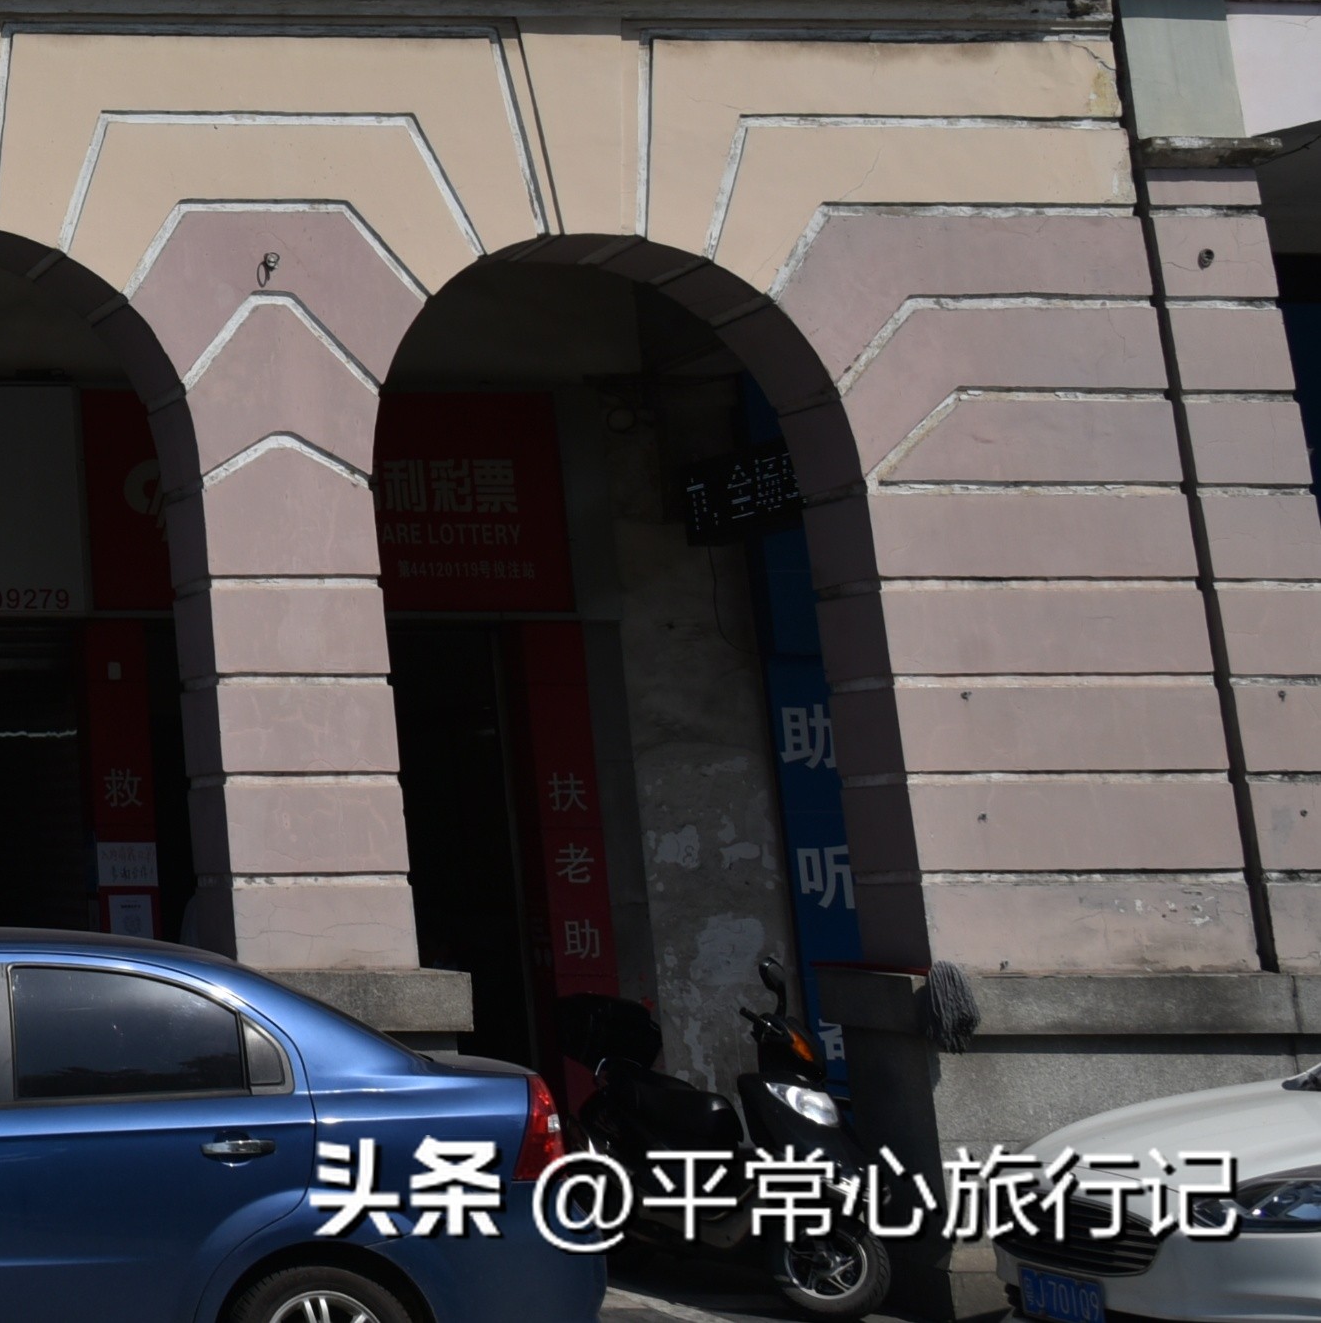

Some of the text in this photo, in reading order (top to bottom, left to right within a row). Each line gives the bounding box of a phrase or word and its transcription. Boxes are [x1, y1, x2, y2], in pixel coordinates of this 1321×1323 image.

[379, 523, 521, 545] ARE LOTTERY
[102, 767, 144, 808] 救
